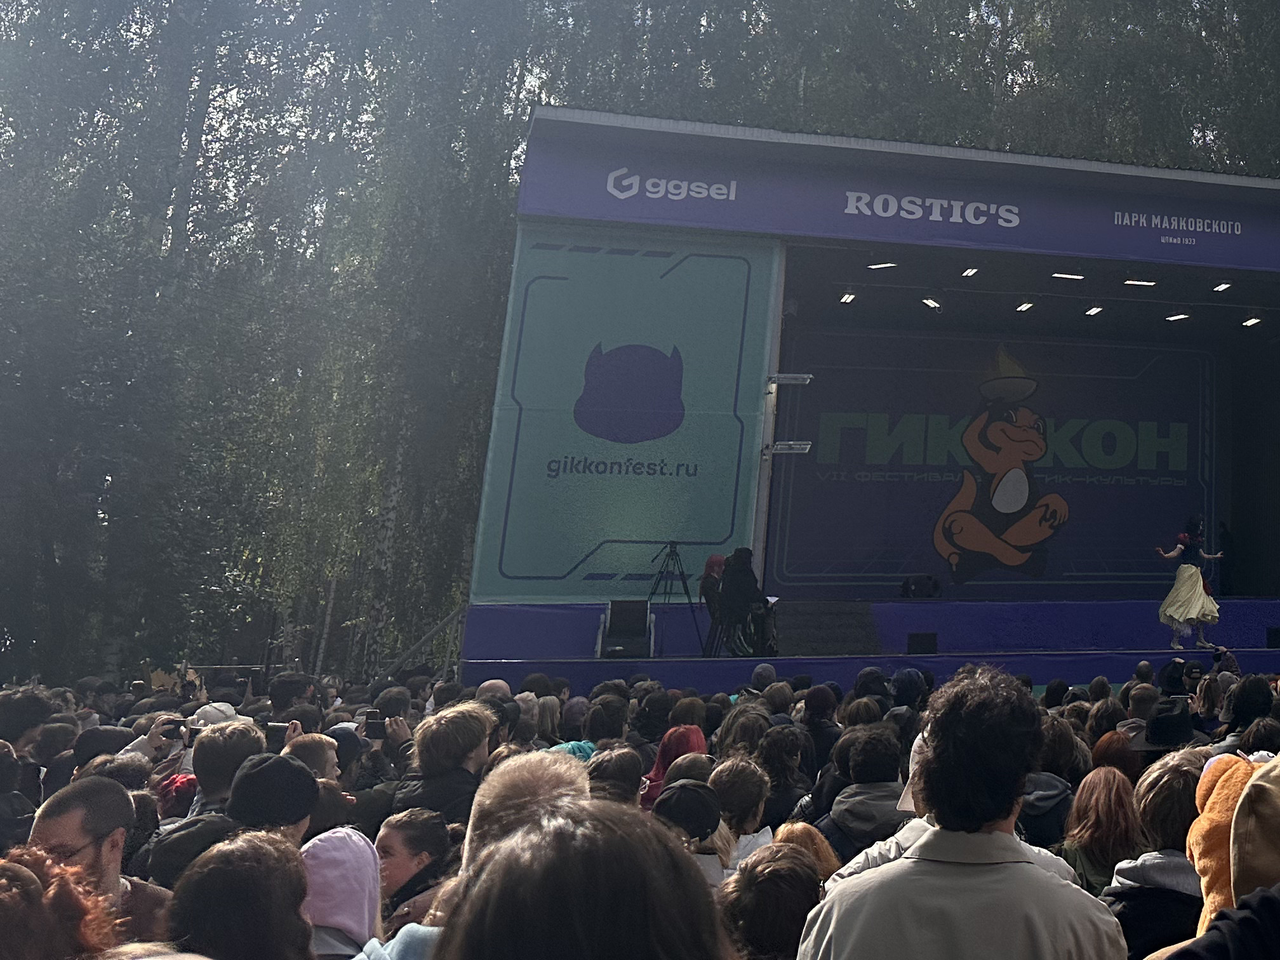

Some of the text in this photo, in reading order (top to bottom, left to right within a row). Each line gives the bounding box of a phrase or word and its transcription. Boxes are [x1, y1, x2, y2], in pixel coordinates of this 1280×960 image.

[645, 178, 737, 200] ggsel
[844, 191, 1020, 228] ROSTIC'S
[1114, 211, 1242, 235] ПАРК МАЯКОВСКОГО
[546, 455, 698, 479] gikkonfest.ru
